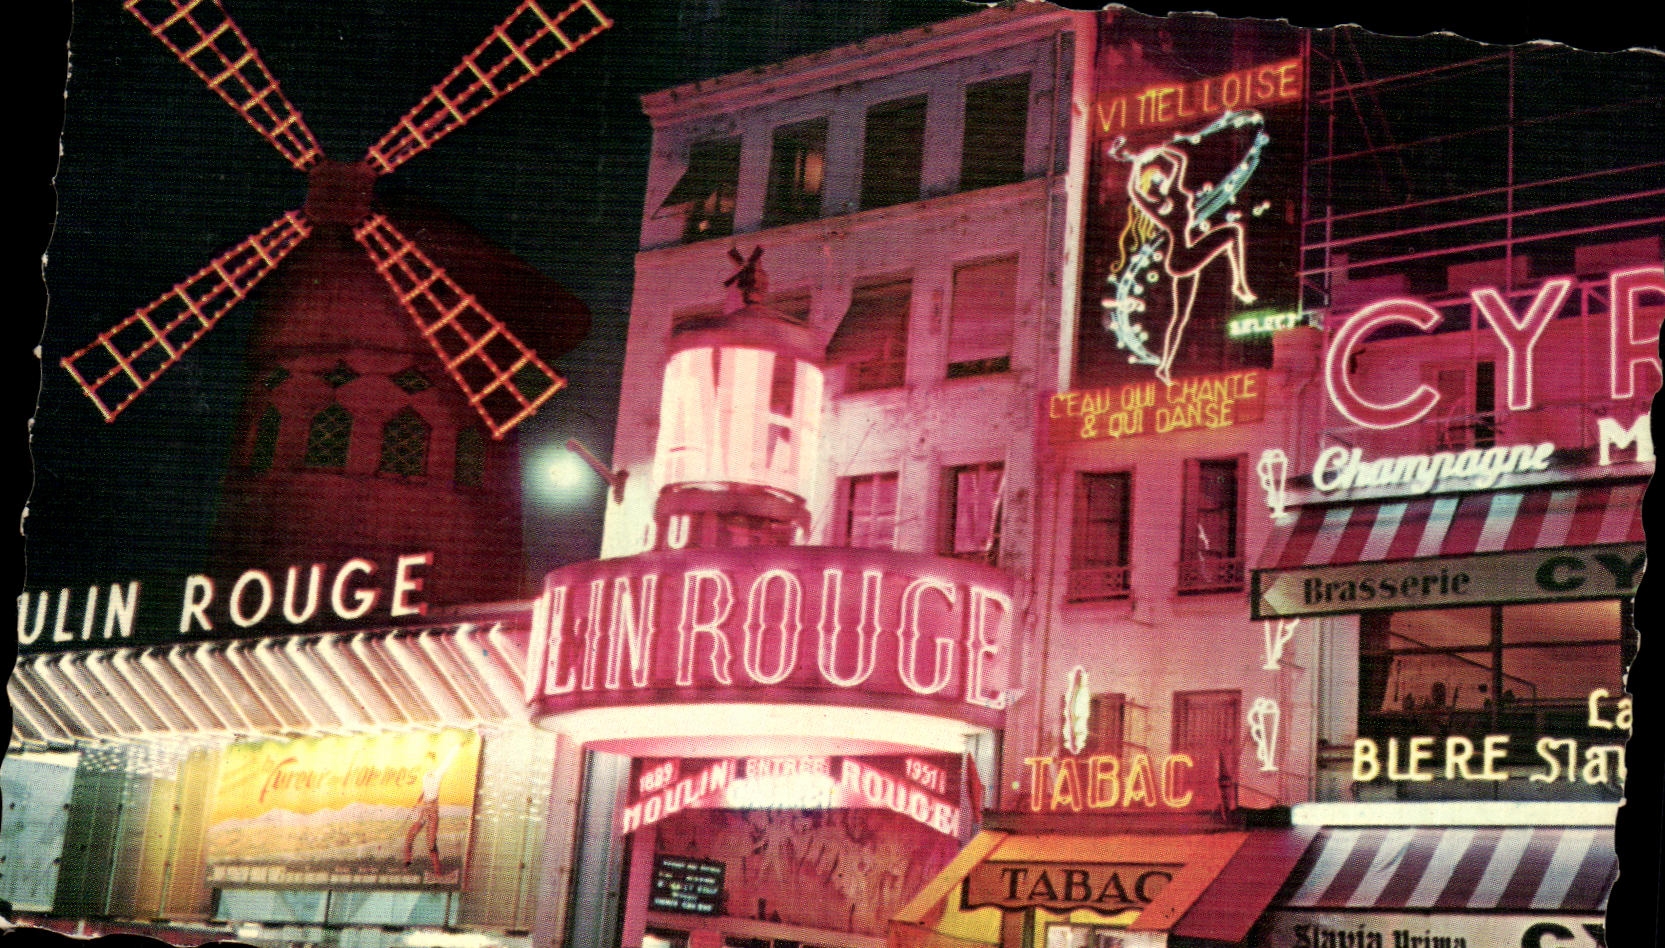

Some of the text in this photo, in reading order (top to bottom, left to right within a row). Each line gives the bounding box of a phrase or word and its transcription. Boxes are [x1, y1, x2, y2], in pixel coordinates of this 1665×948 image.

[1121, 382, 1156, 411] QUI
[1166, 373, 1257, 404] CHANTE
[1080, 399, 1235, 438] & QUI DANSE
[1312, 443, 1555, 496] Champagne
[17, 552, 434, 645] ULIN ROUGE
[1303, 567, 1471, 606] Brasserie
[676, 568, 1013, 709] ROUGE
[1024, 753, 1194, 812] TABAC
[1352, 735, 1511, 782] BIERE
[622, 759, 729, 834] MOULIN
[999, 867, 1174, 904] TABAC
